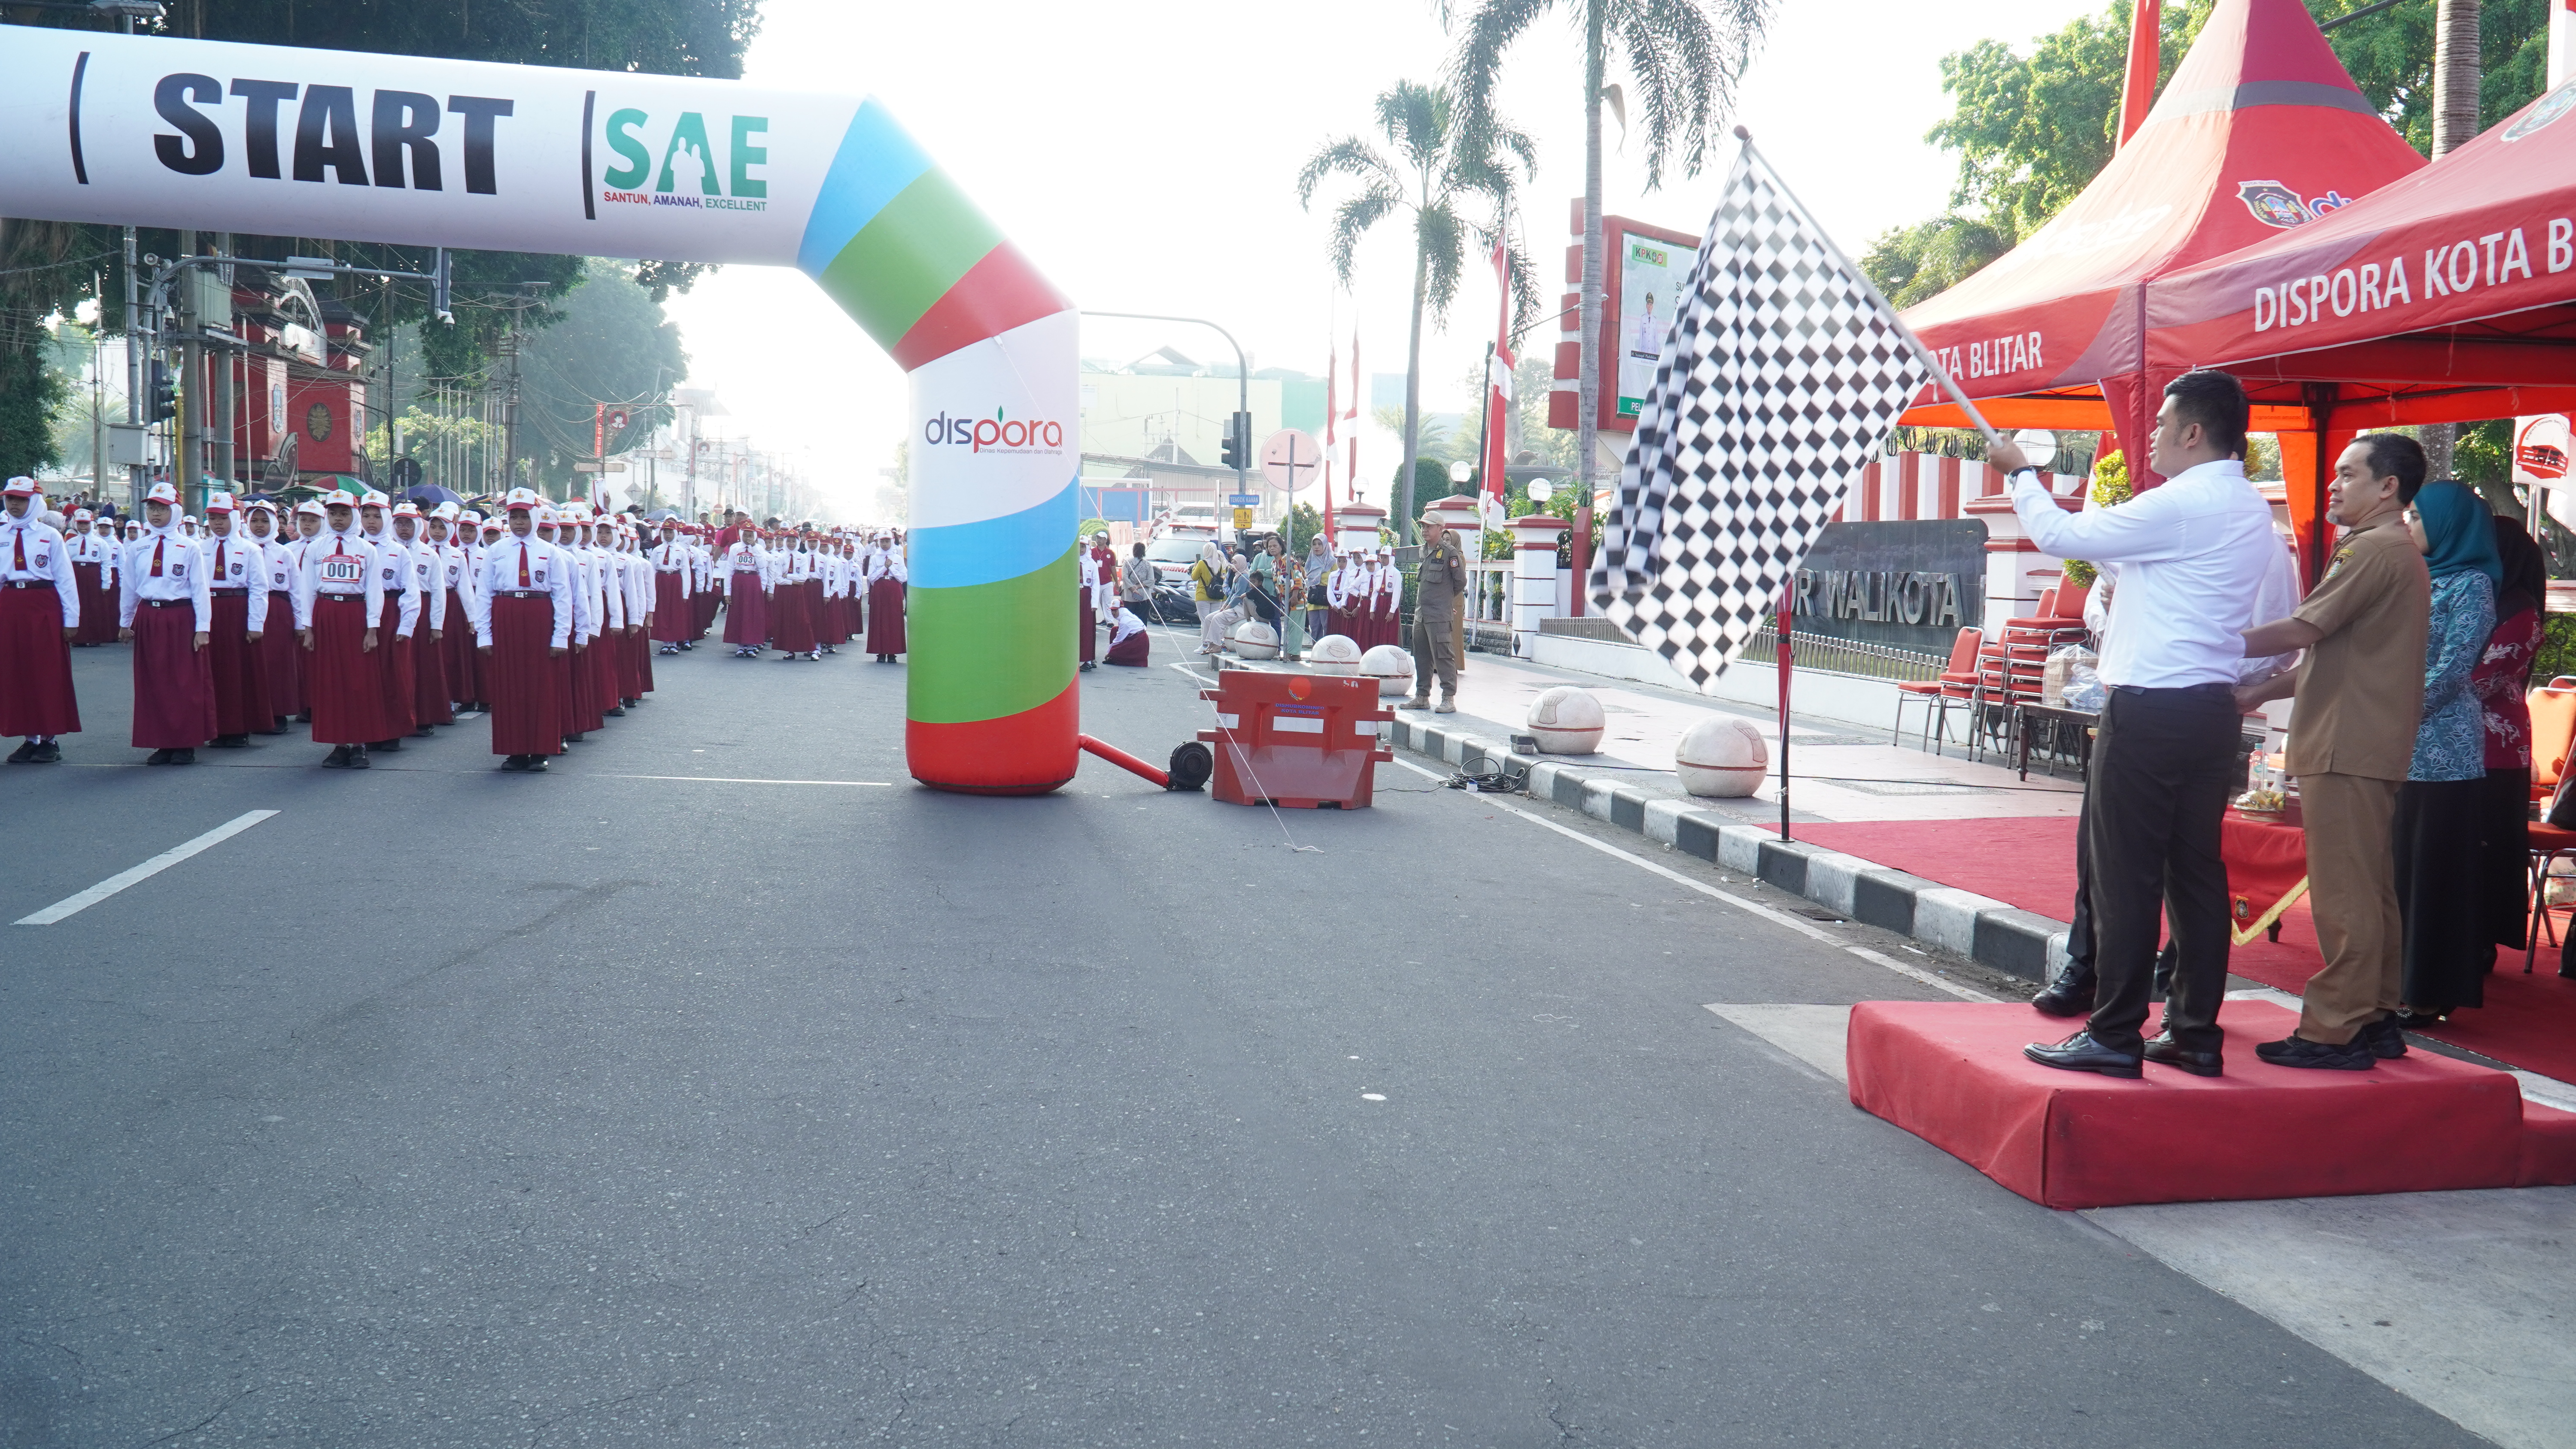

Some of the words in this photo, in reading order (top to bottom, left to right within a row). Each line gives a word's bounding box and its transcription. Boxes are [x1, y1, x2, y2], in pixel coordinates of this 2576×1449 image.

[154, 73, 514, 195] START
[604, 108, 769, 198] SAE
[604, 192, 651, 206] SANTUN,
[653, 195, 703, 209] AMANAH,
[706, 198, 767, 211] EXCELLENT
[1636, 247, 1651, 260] KPK
[1676, 282, 1685, 291] SU
[2254, 256, 2411, 333] DISPORA
[2425, 228, 2533, 300] KOTA
[1970, 331, 2043, 379] BLITAR
[925, 410, 1062, 454] dispora
[328, 563, 354, 578] 001
[738, 555, 753, 564] 003
[1825, 570, 1962, 628] WALIKOTA
